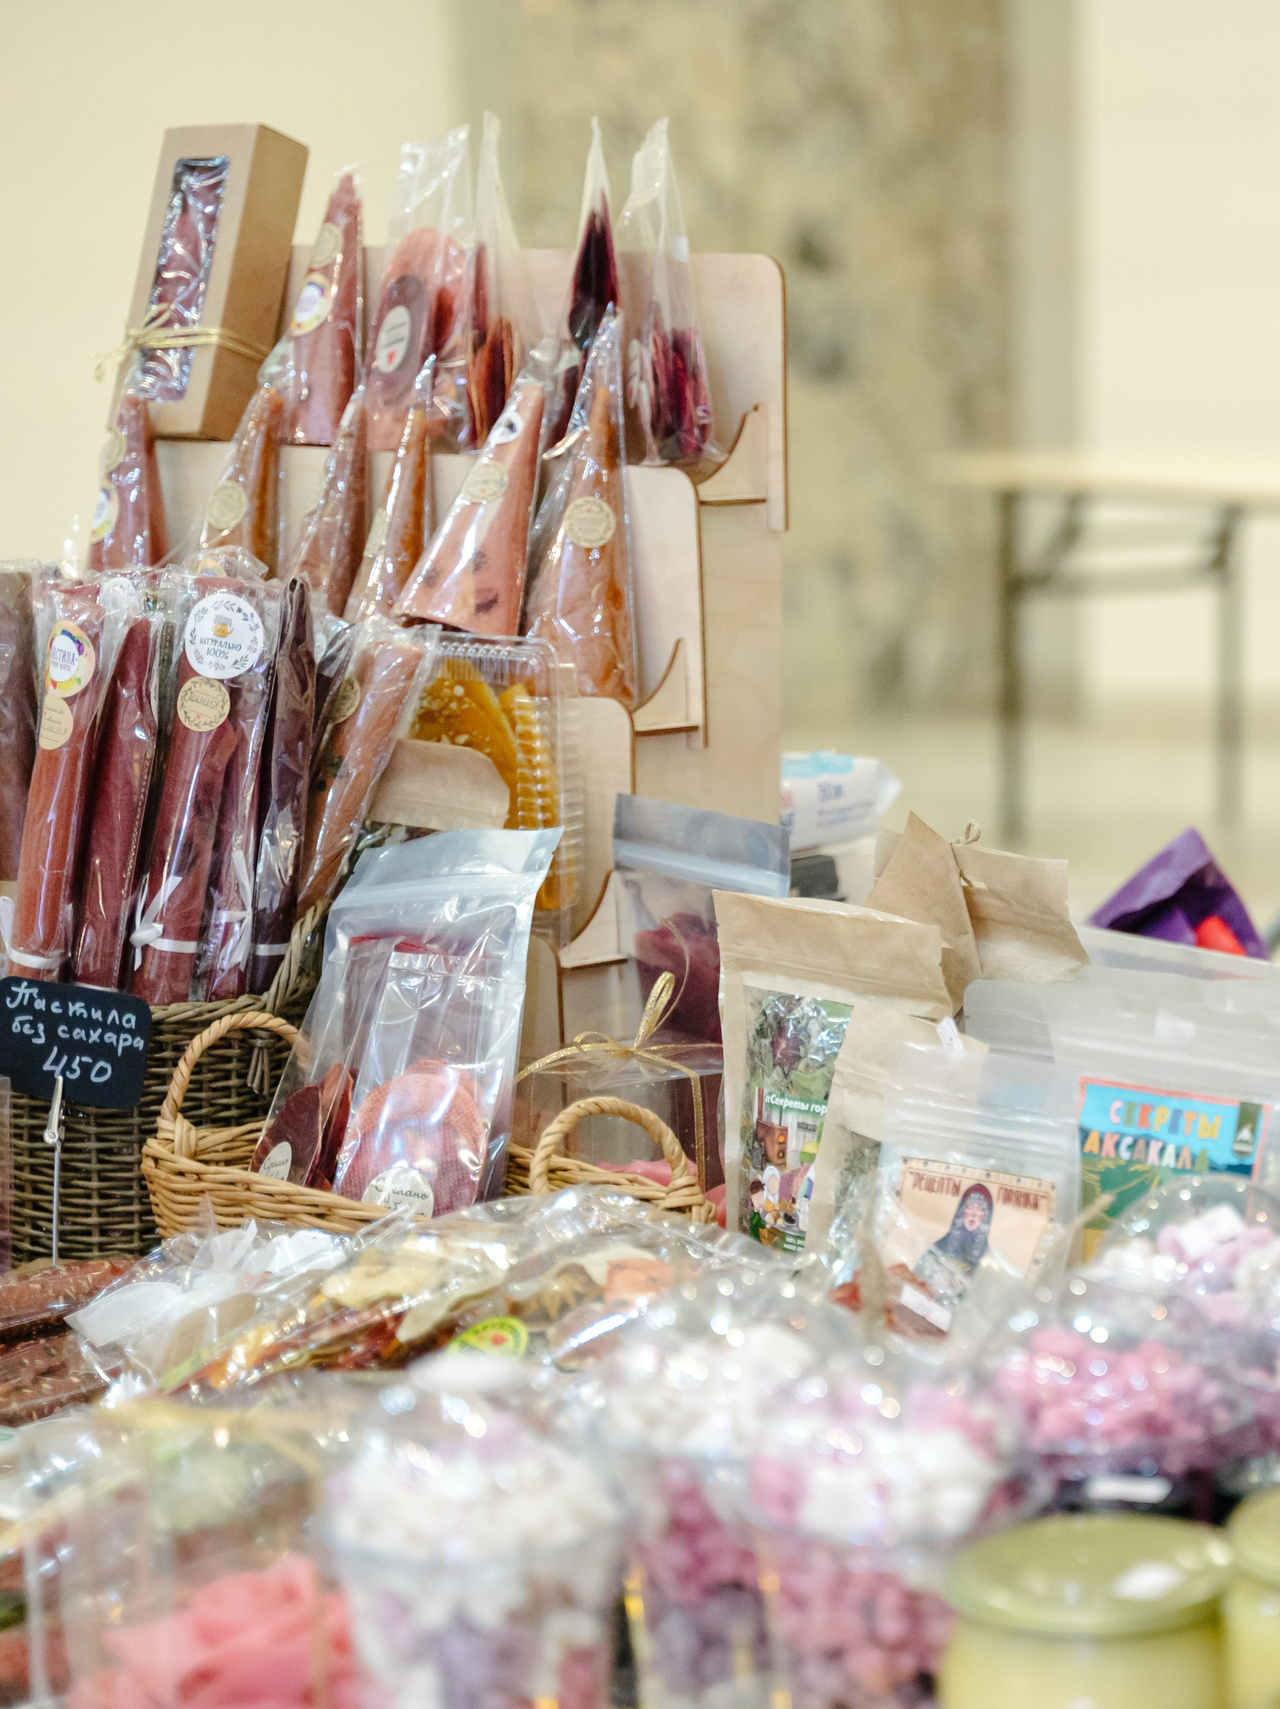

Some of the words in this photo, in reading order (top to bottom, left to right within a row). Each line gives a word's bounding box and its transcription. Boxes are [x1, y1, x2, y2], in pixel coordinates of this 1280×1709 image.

[199, 637, 242, 652] НАТУРАЛЬНО
[206, 647, 229, 660] 100%
[6, 981, 136, 1029] Пастила
[12, 1015, 45, 1044] без
[57, 1024, 145, 1057] сахара
[42, 1046, 112, 1083] 450
[1108, 1100, 1222, 1141] СЕКРЕТЫ
[1083, 1130, 1210, 1174] АКСАКАЛА
